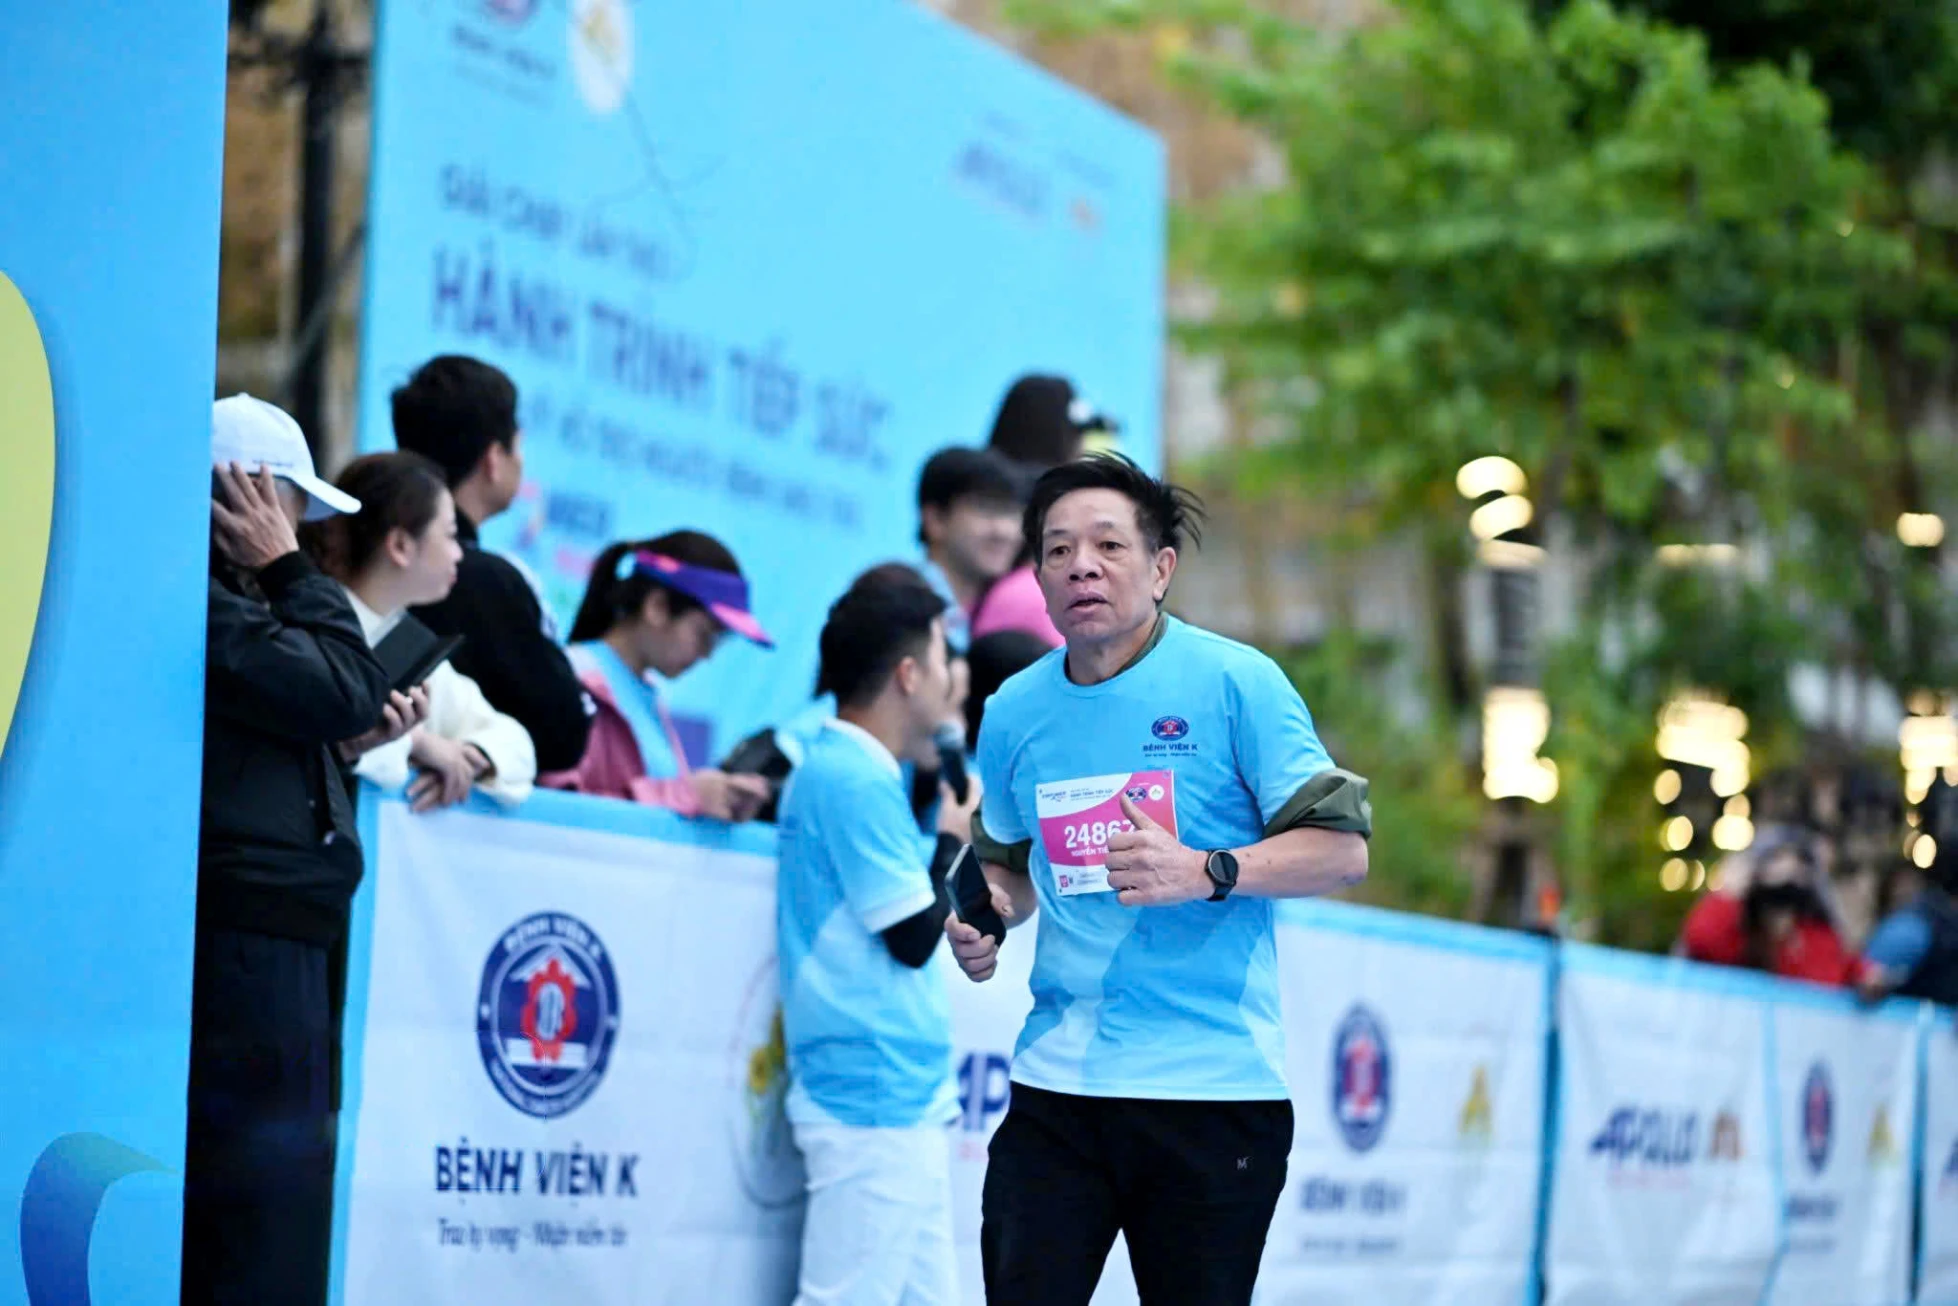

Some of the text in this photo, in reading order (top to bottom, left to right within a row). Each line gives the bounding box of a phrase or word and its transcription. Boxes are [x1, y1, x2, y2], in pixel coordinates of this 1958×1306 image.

[1190, 743, 1198, 751] K
[436, 1136, 641, 1207] BỆNH VIỆN K
